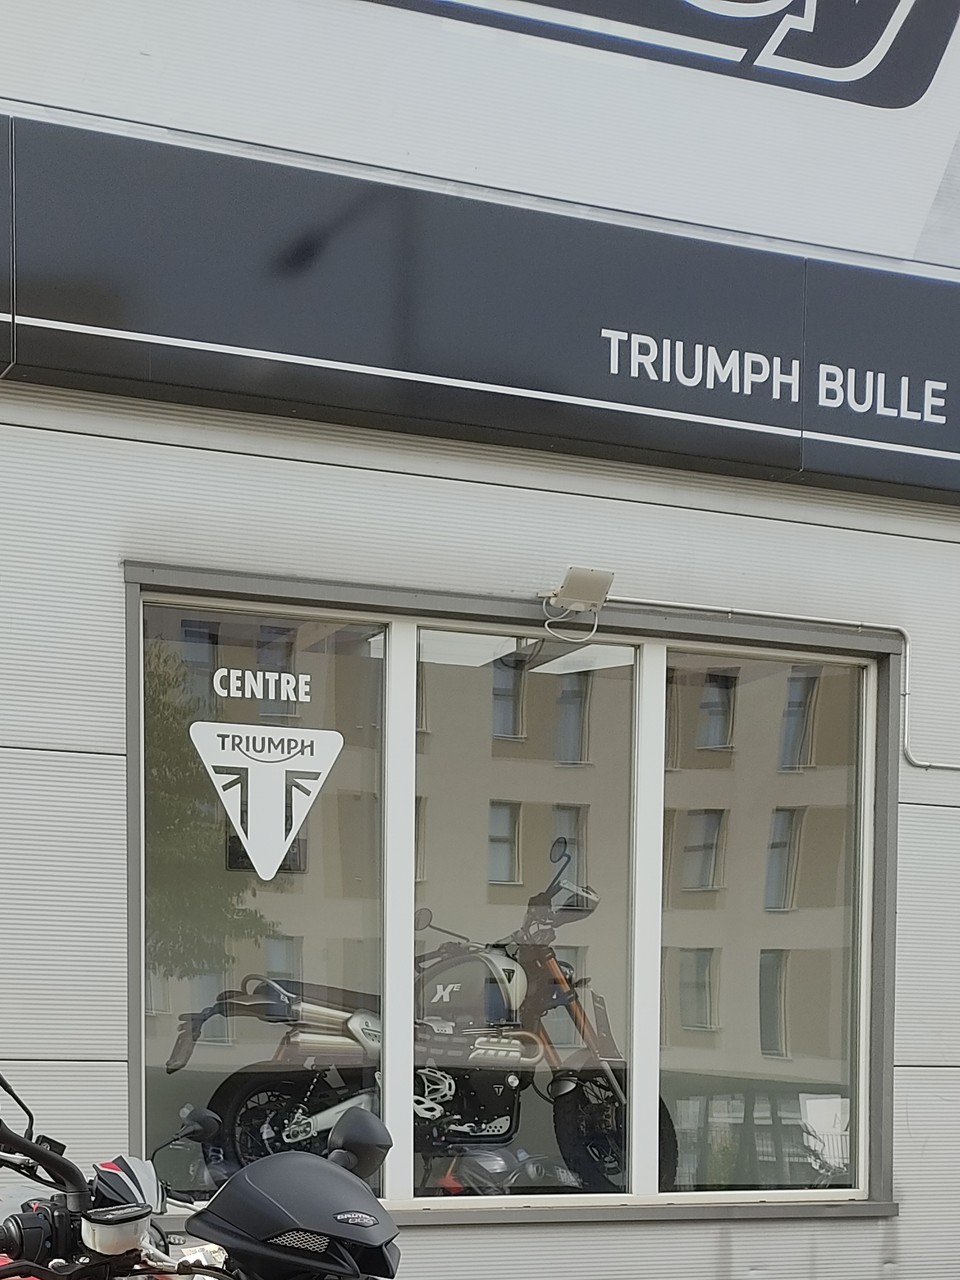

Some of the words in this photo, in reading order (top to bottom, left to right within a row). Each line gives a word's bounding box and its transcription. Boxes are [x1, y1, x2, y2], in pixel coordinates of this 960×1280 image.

[600, 328, 801, 403] TRIUMPH
[817, 363, 948, 425] BULLE
[212, 667, 312, 703] CENTRE
[216, 733, 316, 763] TRIUMPH
